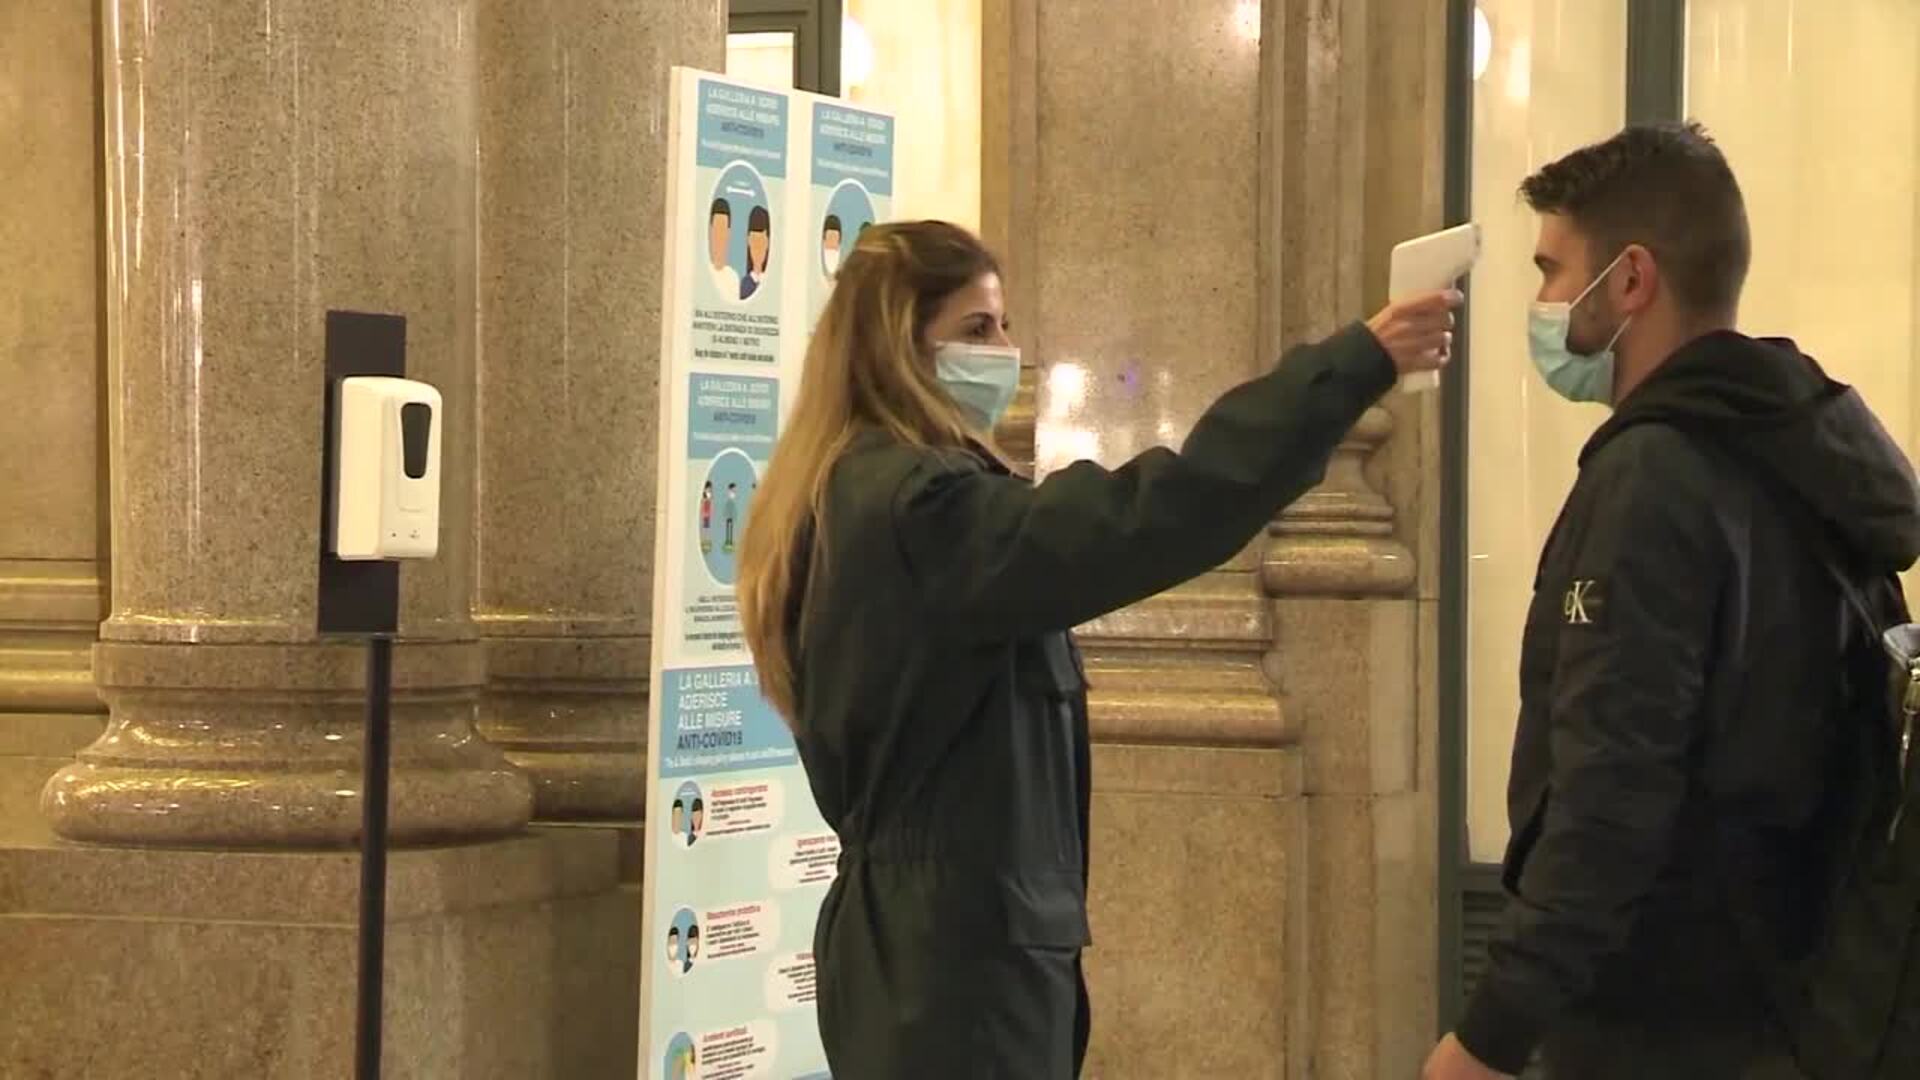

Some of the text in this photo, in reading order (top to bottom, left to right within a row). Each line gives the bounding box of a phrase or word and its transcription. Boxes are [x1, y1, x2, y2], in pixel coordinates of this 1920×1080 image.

[679, 673, 691, 691] LA
[694, 671, 741, 689] GALLERIA
[678, 691, 728, 710] ADERISCE
[678, 710, 742, 730] ALLE MISURE
